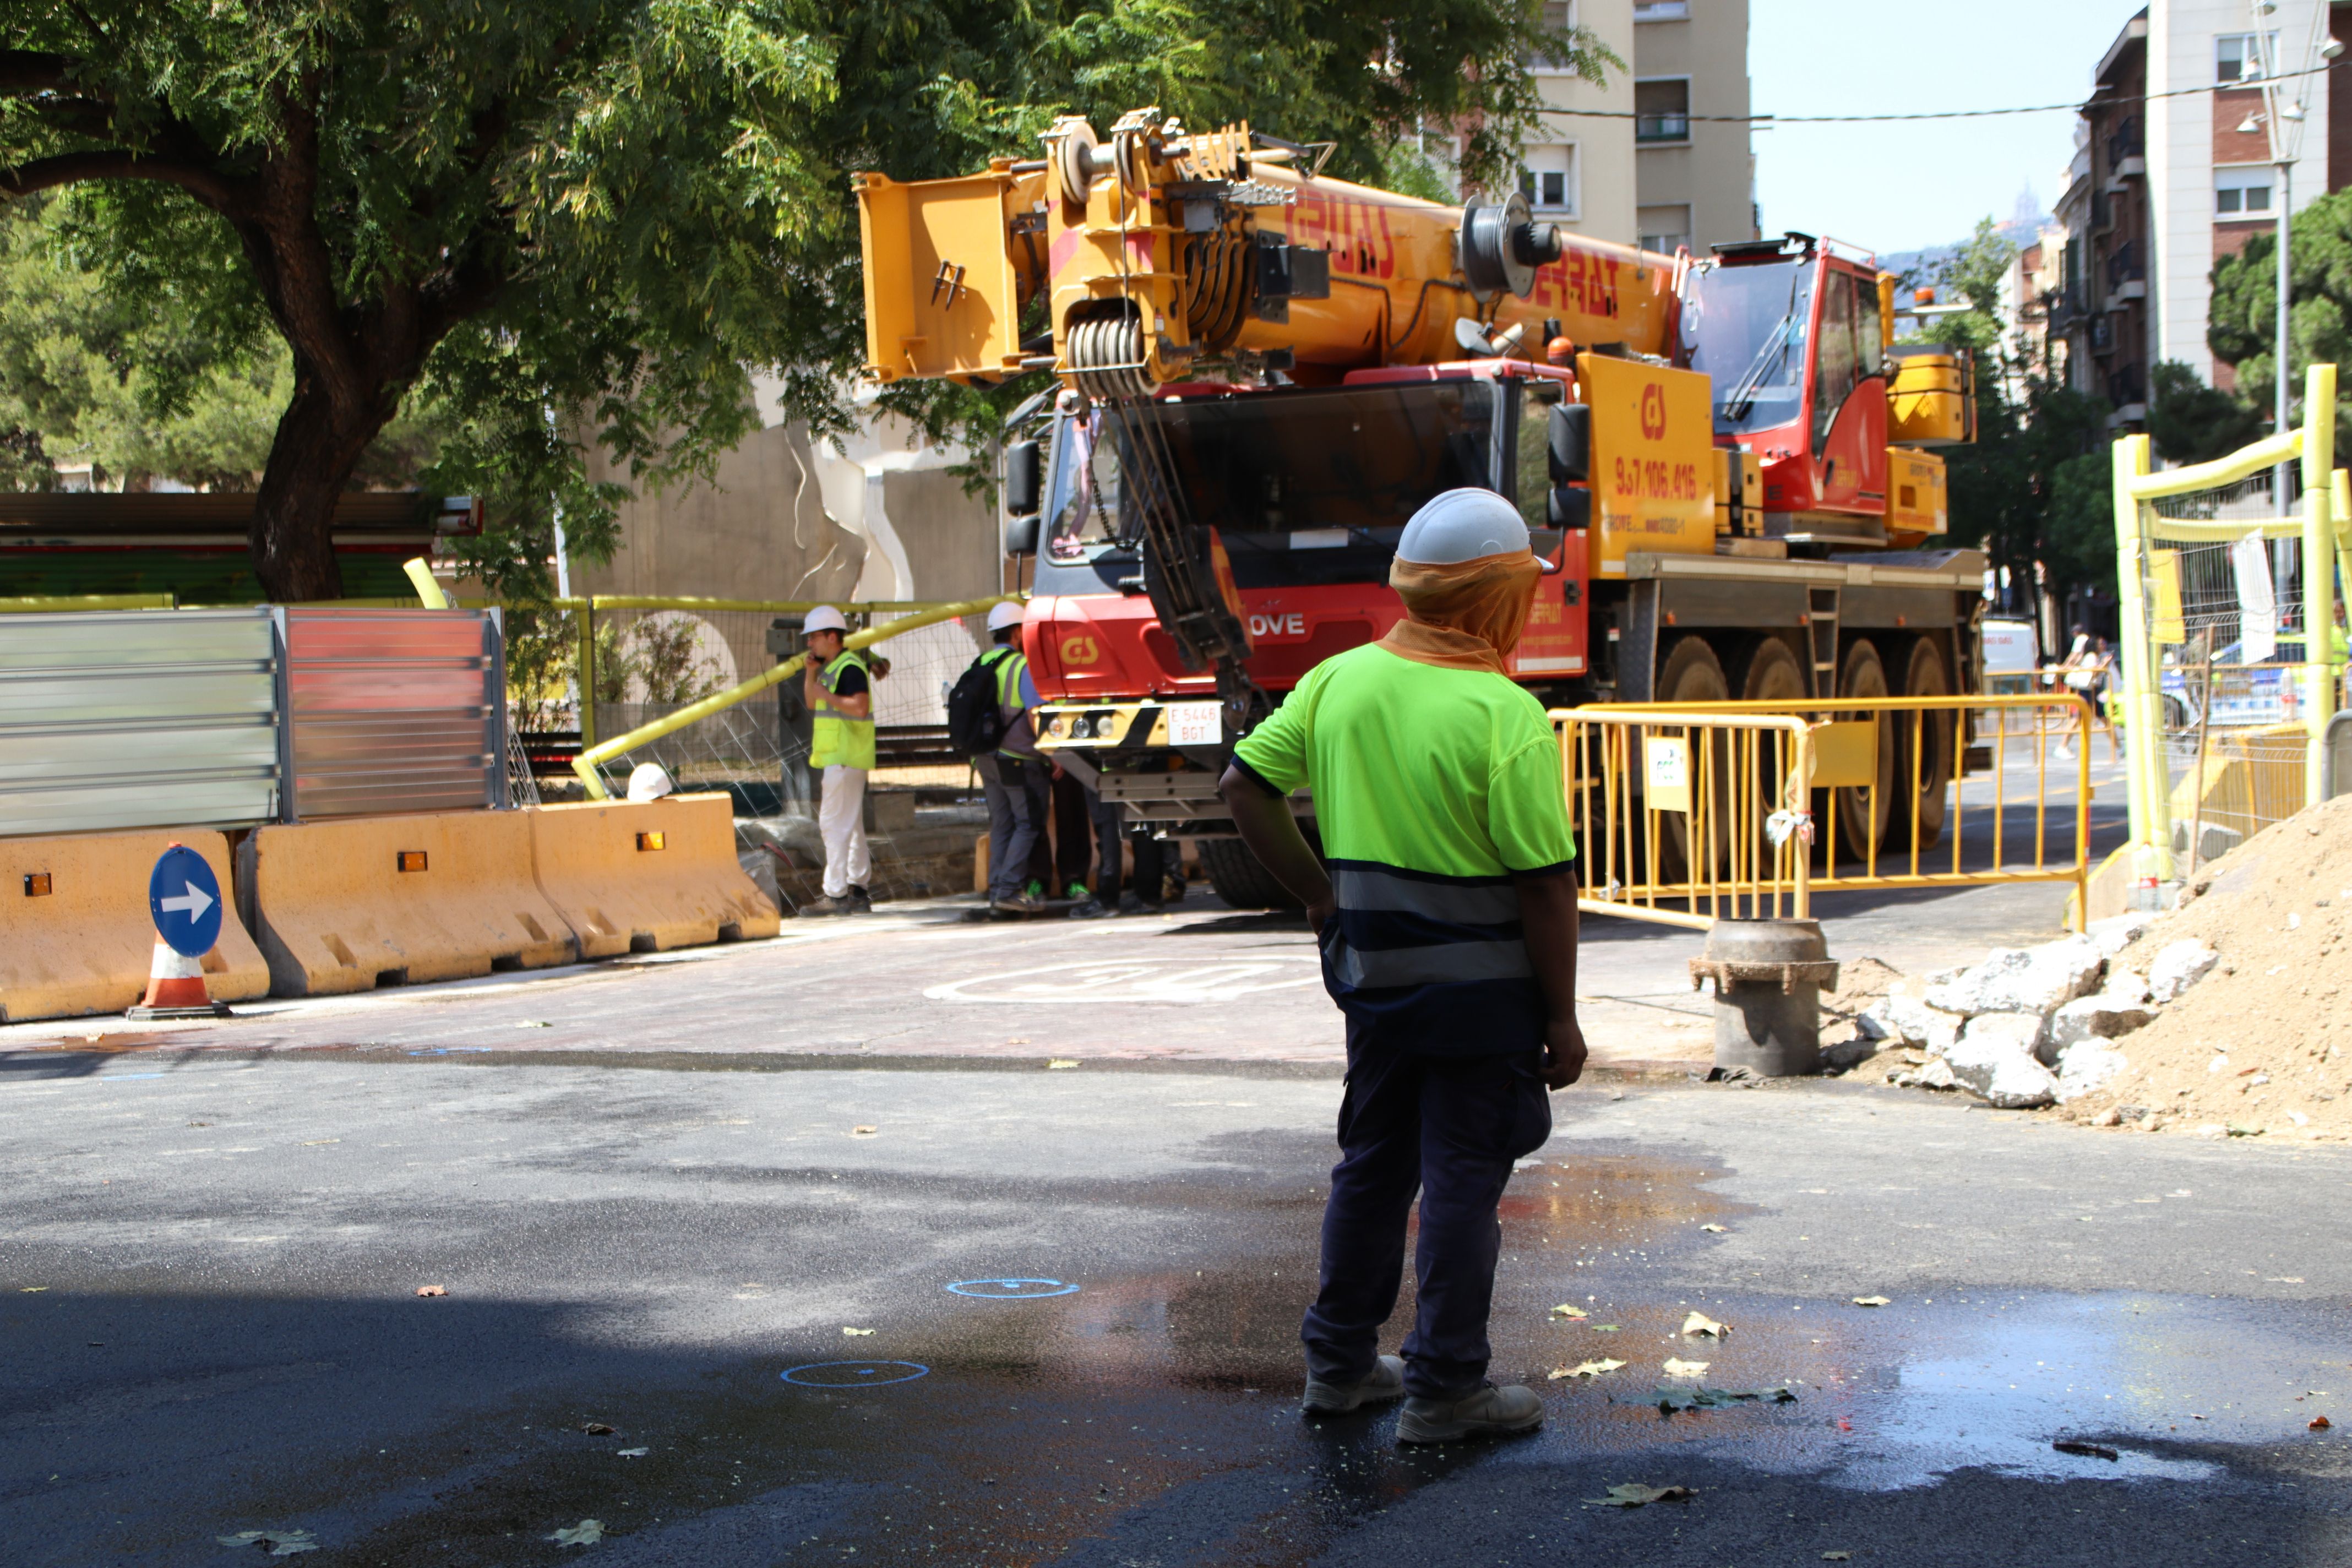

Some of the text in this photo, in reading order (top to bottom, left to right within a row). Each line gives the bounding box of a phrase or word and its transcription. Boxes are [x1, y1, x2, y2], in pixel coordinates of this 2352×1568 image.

[1521, 246, 1619, 320] ERRAT
[1249, 613, 1305, 636] OVE
[1171, 707, 1216, 722] E 5446
[1182, 726, 1206, 741] BGT
